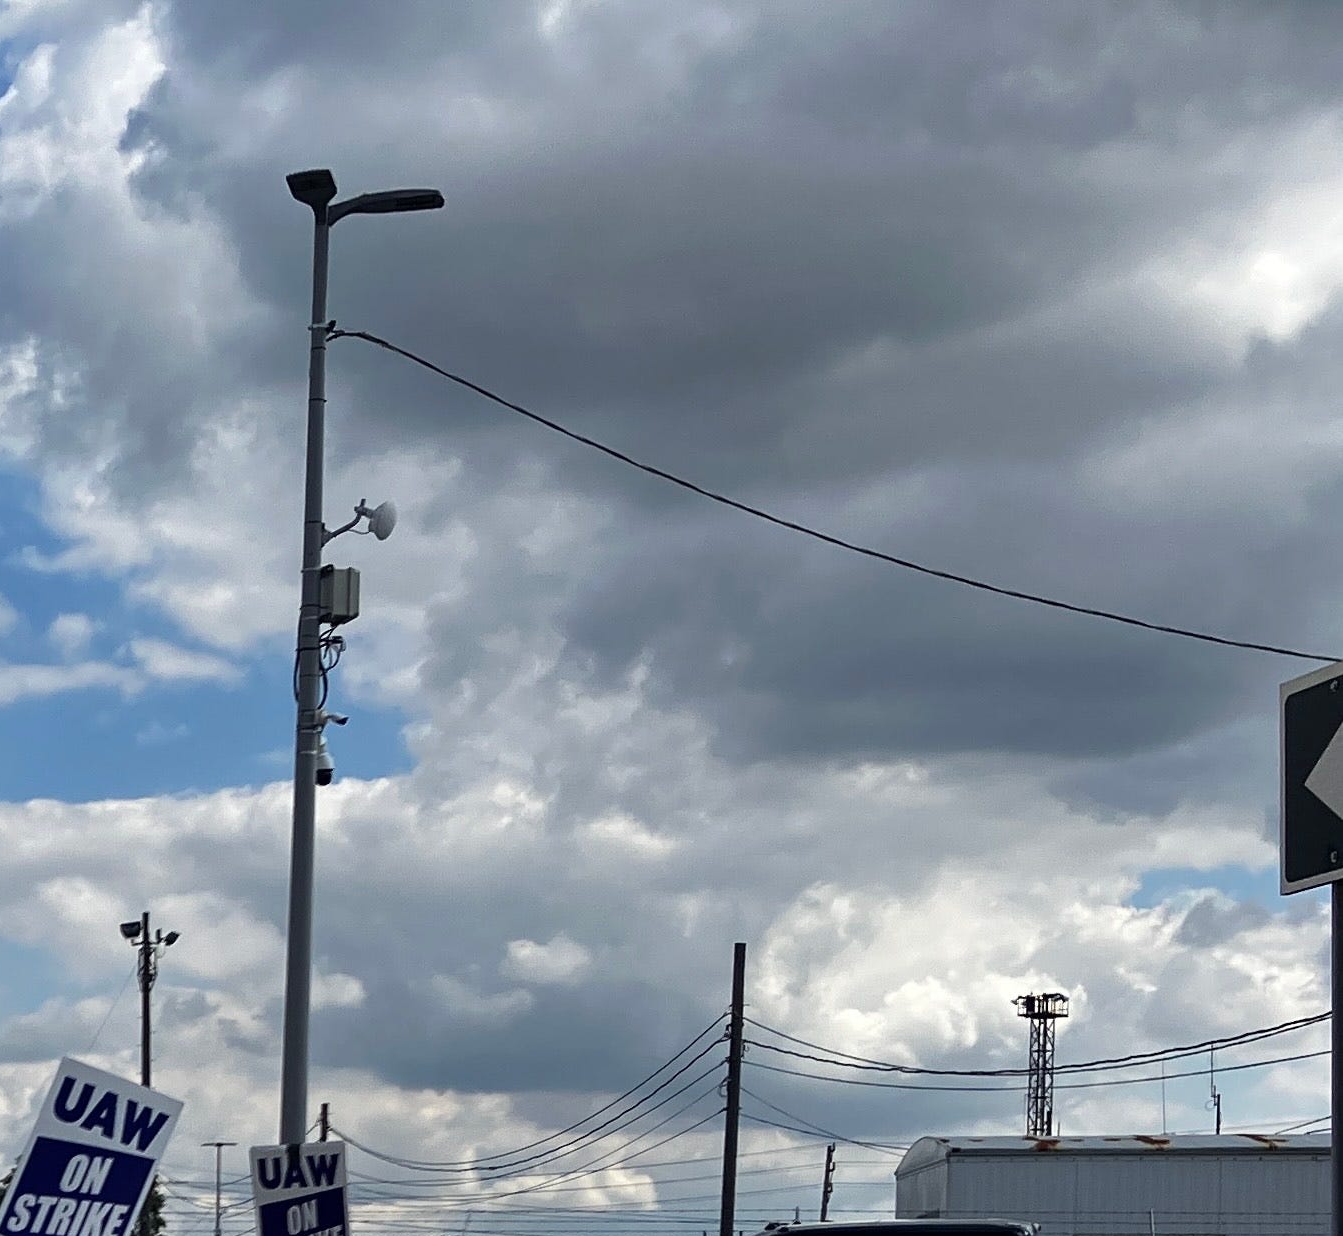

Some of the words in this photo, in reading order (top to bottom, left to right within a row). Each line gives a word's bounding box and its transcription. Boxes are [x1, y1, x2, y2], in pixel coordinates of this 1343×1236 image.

[54, 1076, 170, 1152] UAW
[59, 1154, 114, 1195] ON
[258, 1153, 340, 1190] UAW
[286, 1199, 318, 1235] ON
